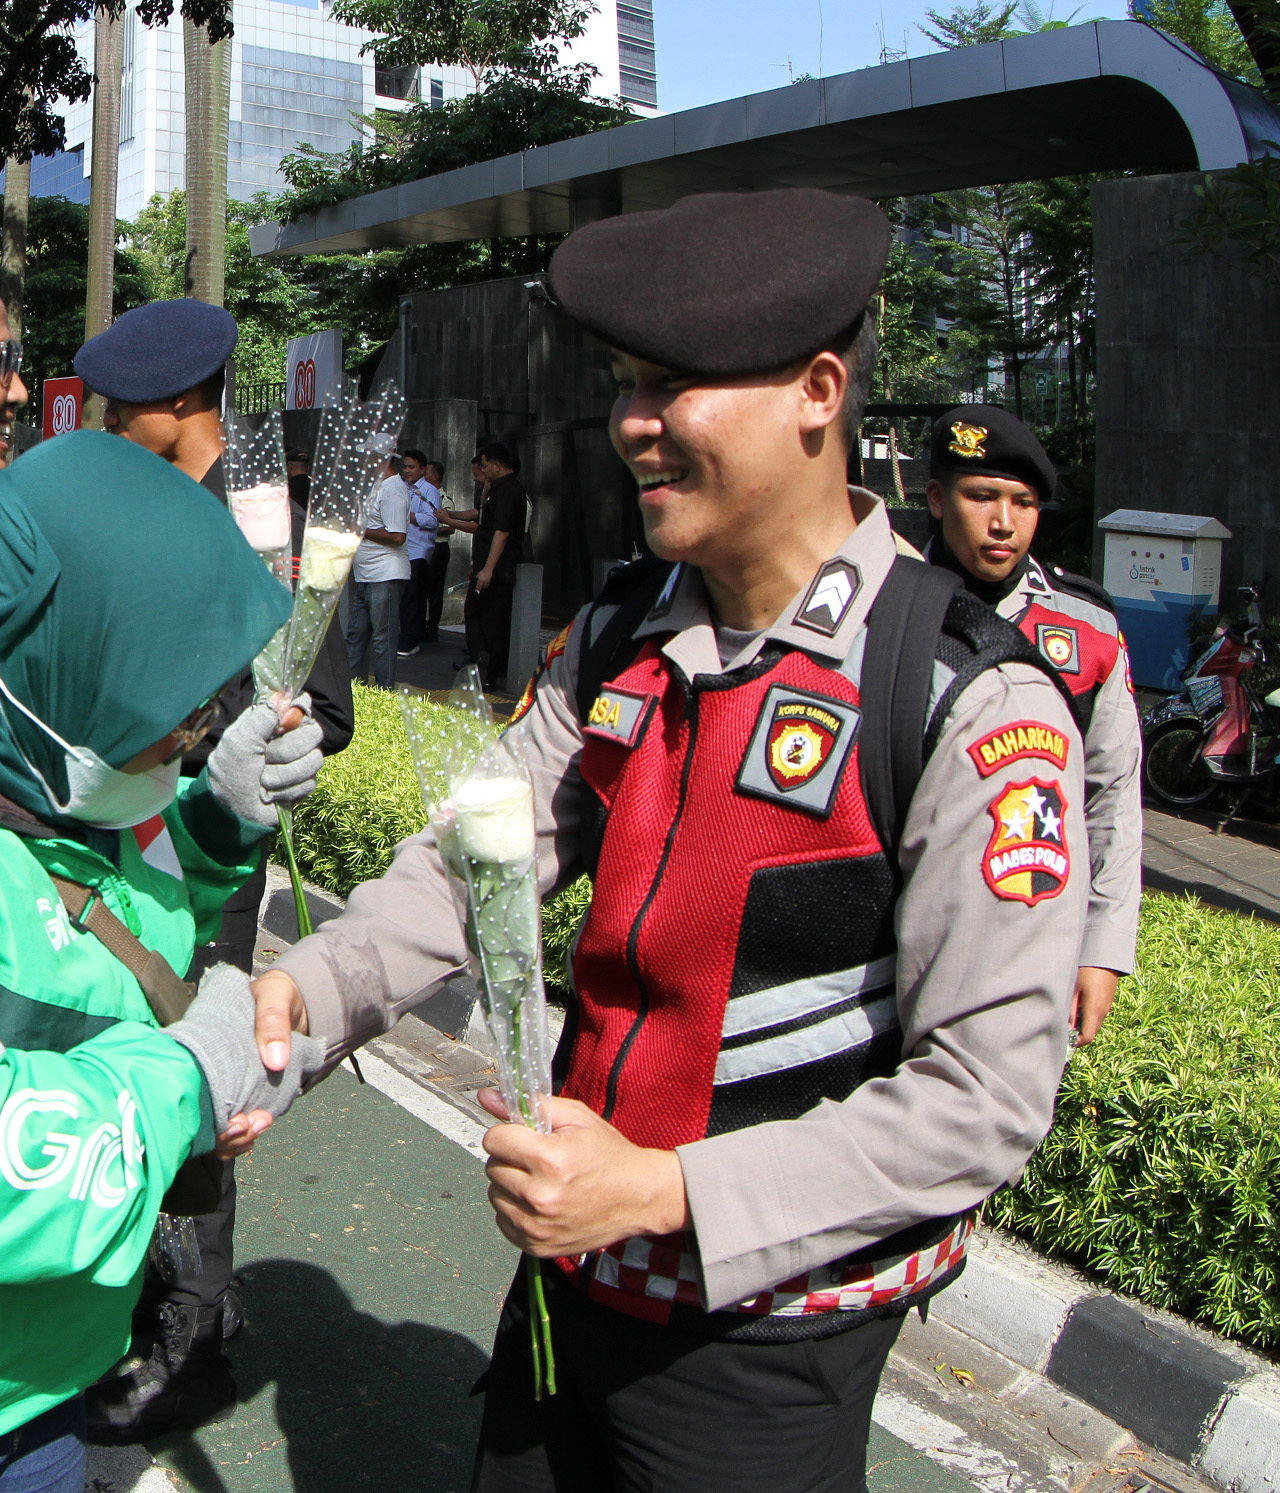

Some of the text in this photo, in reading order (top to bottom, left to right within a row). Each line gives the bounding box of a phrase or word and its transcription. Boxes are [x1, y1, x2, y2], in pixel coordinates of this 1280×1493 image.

[295, 359, 315, 410] 80
[52, 394, 77, 435] 80
[778, 704, 806, 717] KORPS
[989, 847, 1035, 879] MABES
